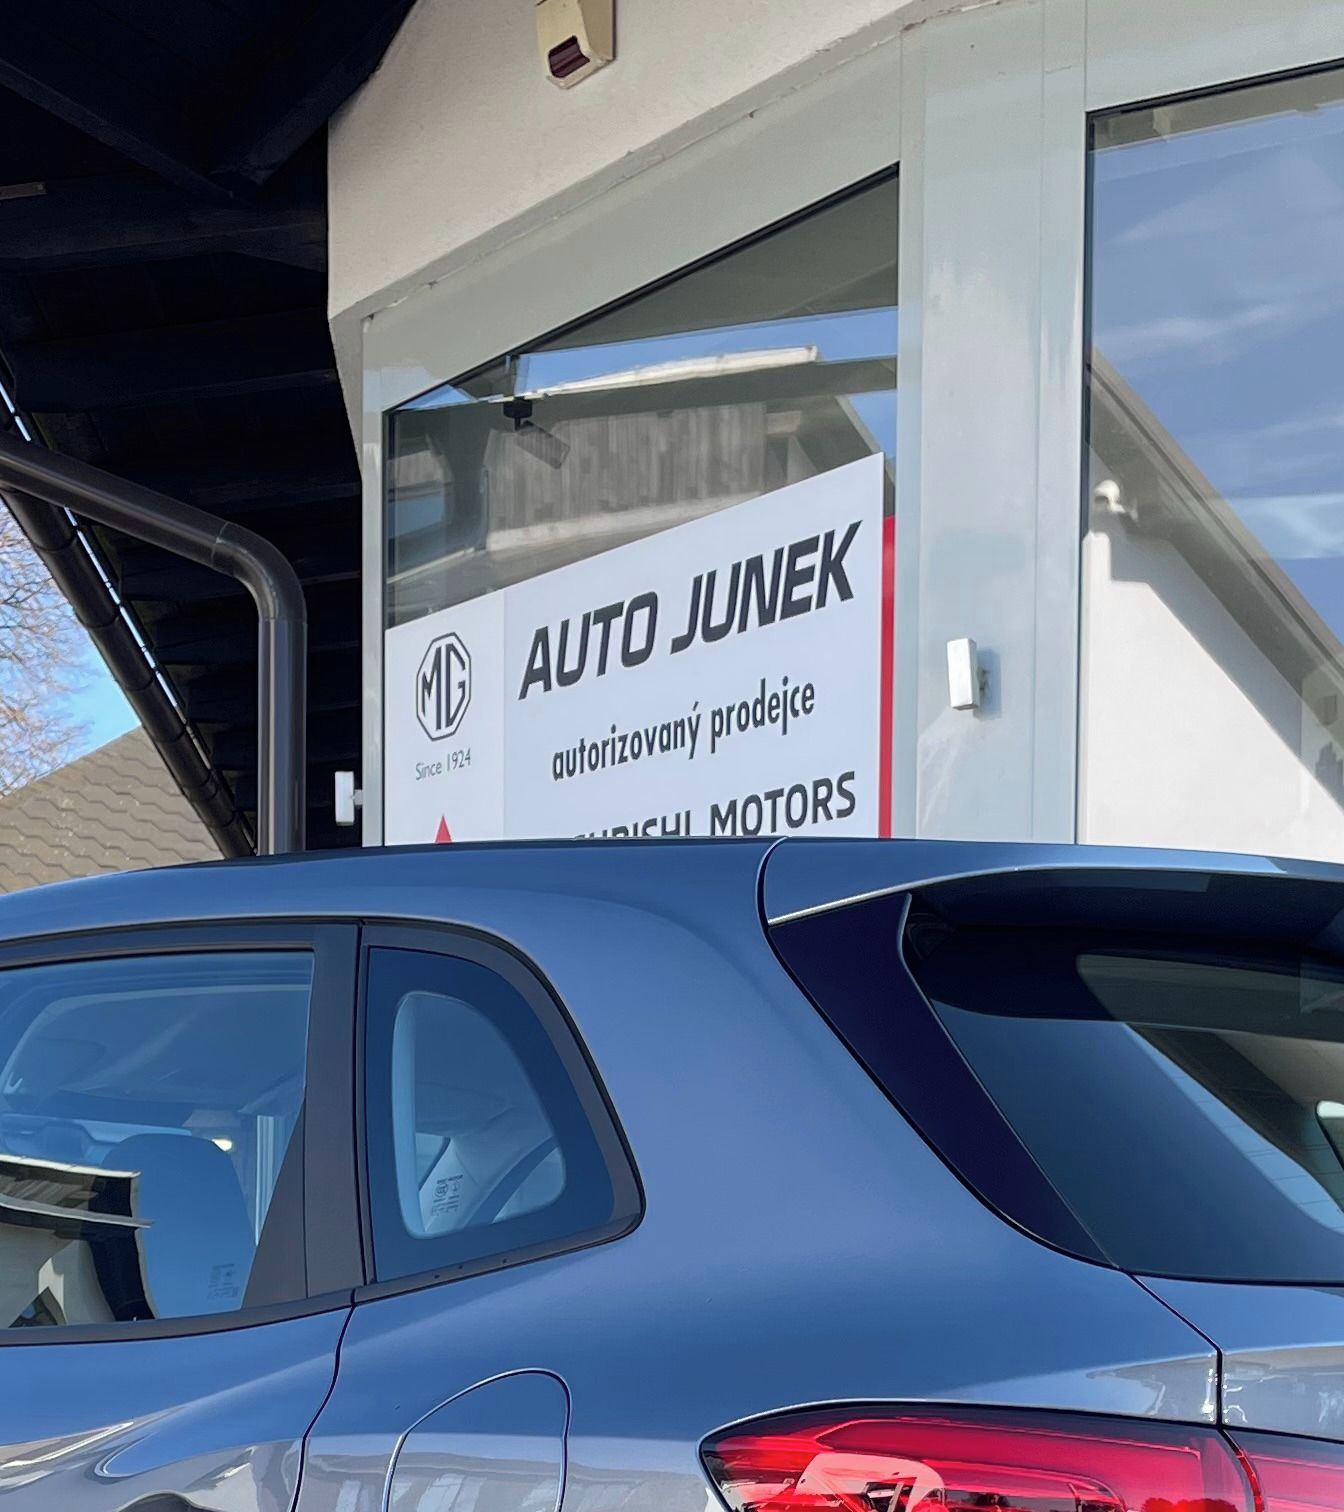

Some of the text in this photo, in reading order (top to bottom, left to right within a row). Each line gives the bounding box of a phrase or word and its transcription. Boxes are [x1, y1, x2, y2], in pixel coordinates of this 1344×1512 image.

[518, 519, 864, 700] AUTO JUNEK
[420, 640, 468, 733] MG
[552, 676, 816, 781] autorizovaný prodejce
[415, 748, 472, 781] Since 1924
[709, 771, 856, 837] MOTORS
